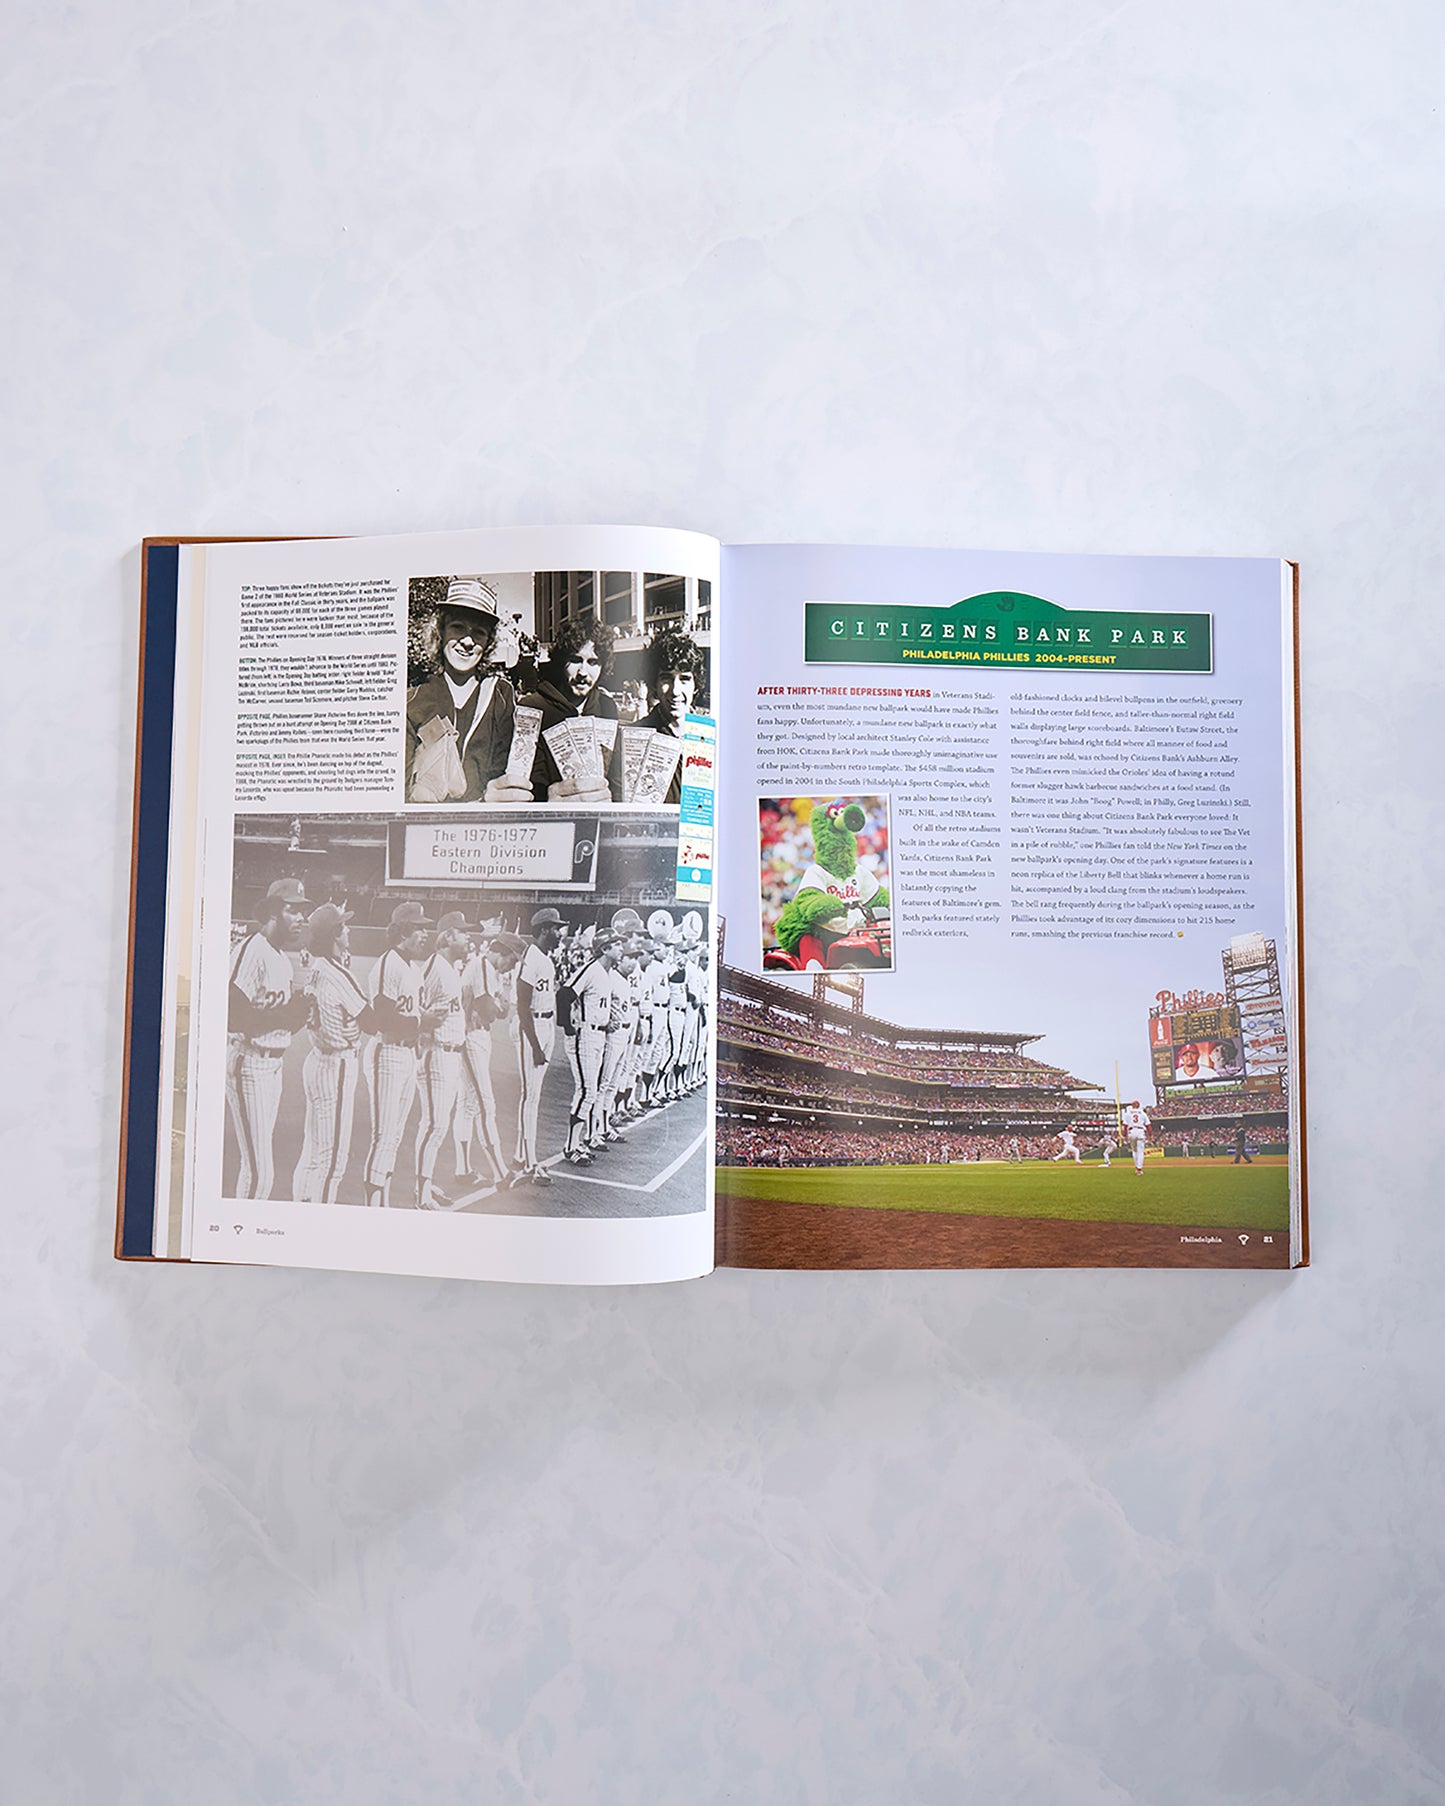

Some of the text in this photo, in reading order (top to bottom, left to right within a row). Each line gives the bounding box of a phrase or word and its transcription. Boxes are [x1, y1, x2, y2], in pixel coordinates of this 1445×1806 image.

[830, 619, 1187, 645] CITIZENS BANK PARK
[902, 649, 1116, 665] PHILADELPHIA PHILLIES 2004-PRESENT
[757, 686, 784, 695] AFTER
[787, 686, 847, 695] THIRTY-THREE
[849, 687, 902, 696] DEPRESSING
[904, 688, 931, 697] YEARS
[434, 828, 538, 842] The 1976-1977
[898, 838, 916, 846] built
[927, 838, 940, 846] the
[960, 839, 969, 847] of
[969, 839, 1000, 847] Camden
[432, 844, 547, 858] Eastern Division
[899, 853, 923, 861] Yards,
[923, 853, 954, 861] Citizens
[975, 854, 992, 862] Park
[449, 861, 524, 877] Champions
[914, 868, 928, 876] the
[535, 978, 549, 992] 31
[397, 995, 413, 1013] 20
[1155, 989, 1225, 1014] Phillies
[1132, 1114, 1139, 1124] 3
